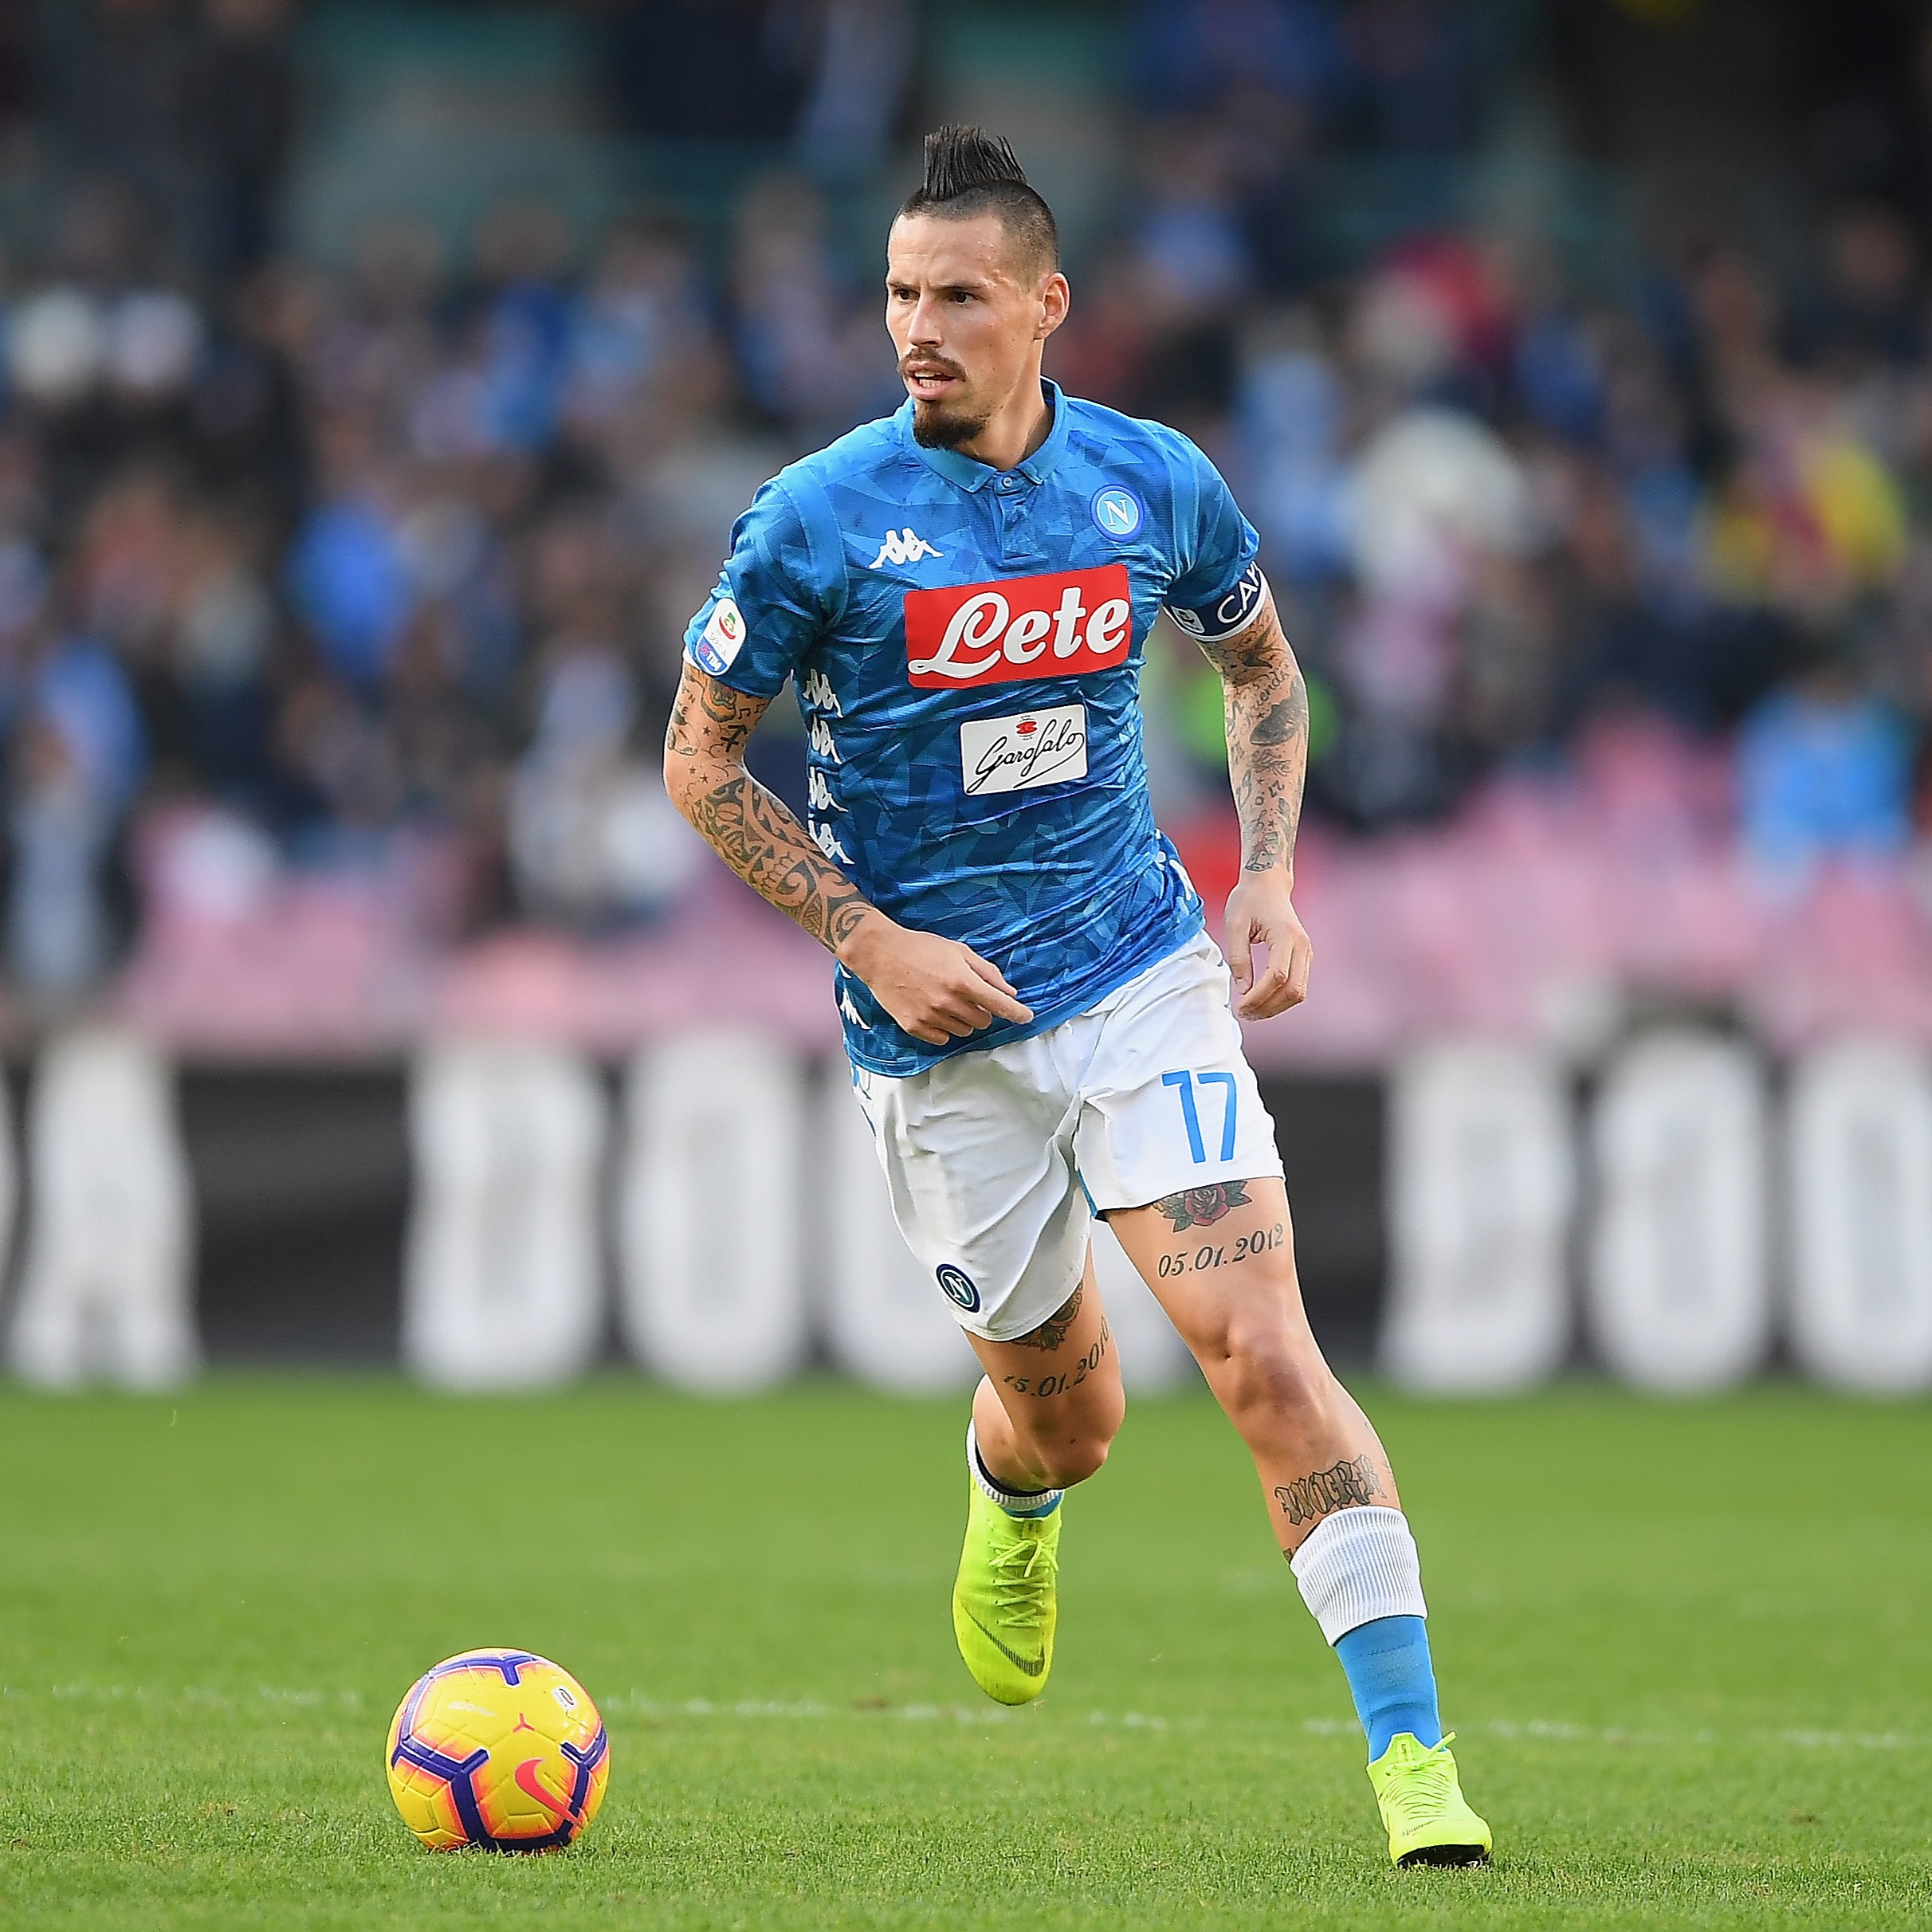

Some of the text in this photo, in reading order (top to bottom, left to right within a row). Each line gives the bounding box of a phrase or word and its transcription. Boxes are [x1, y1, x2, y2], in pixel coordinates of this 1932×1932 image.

[1102, 499, 1129, 526] N
[908, 587, 1129, 679] Lete
[966, 718, 1085, 794] Garofalo
[1161, 1070, 1236, 1164] 17
[944, 1275, 970, 1302] N
